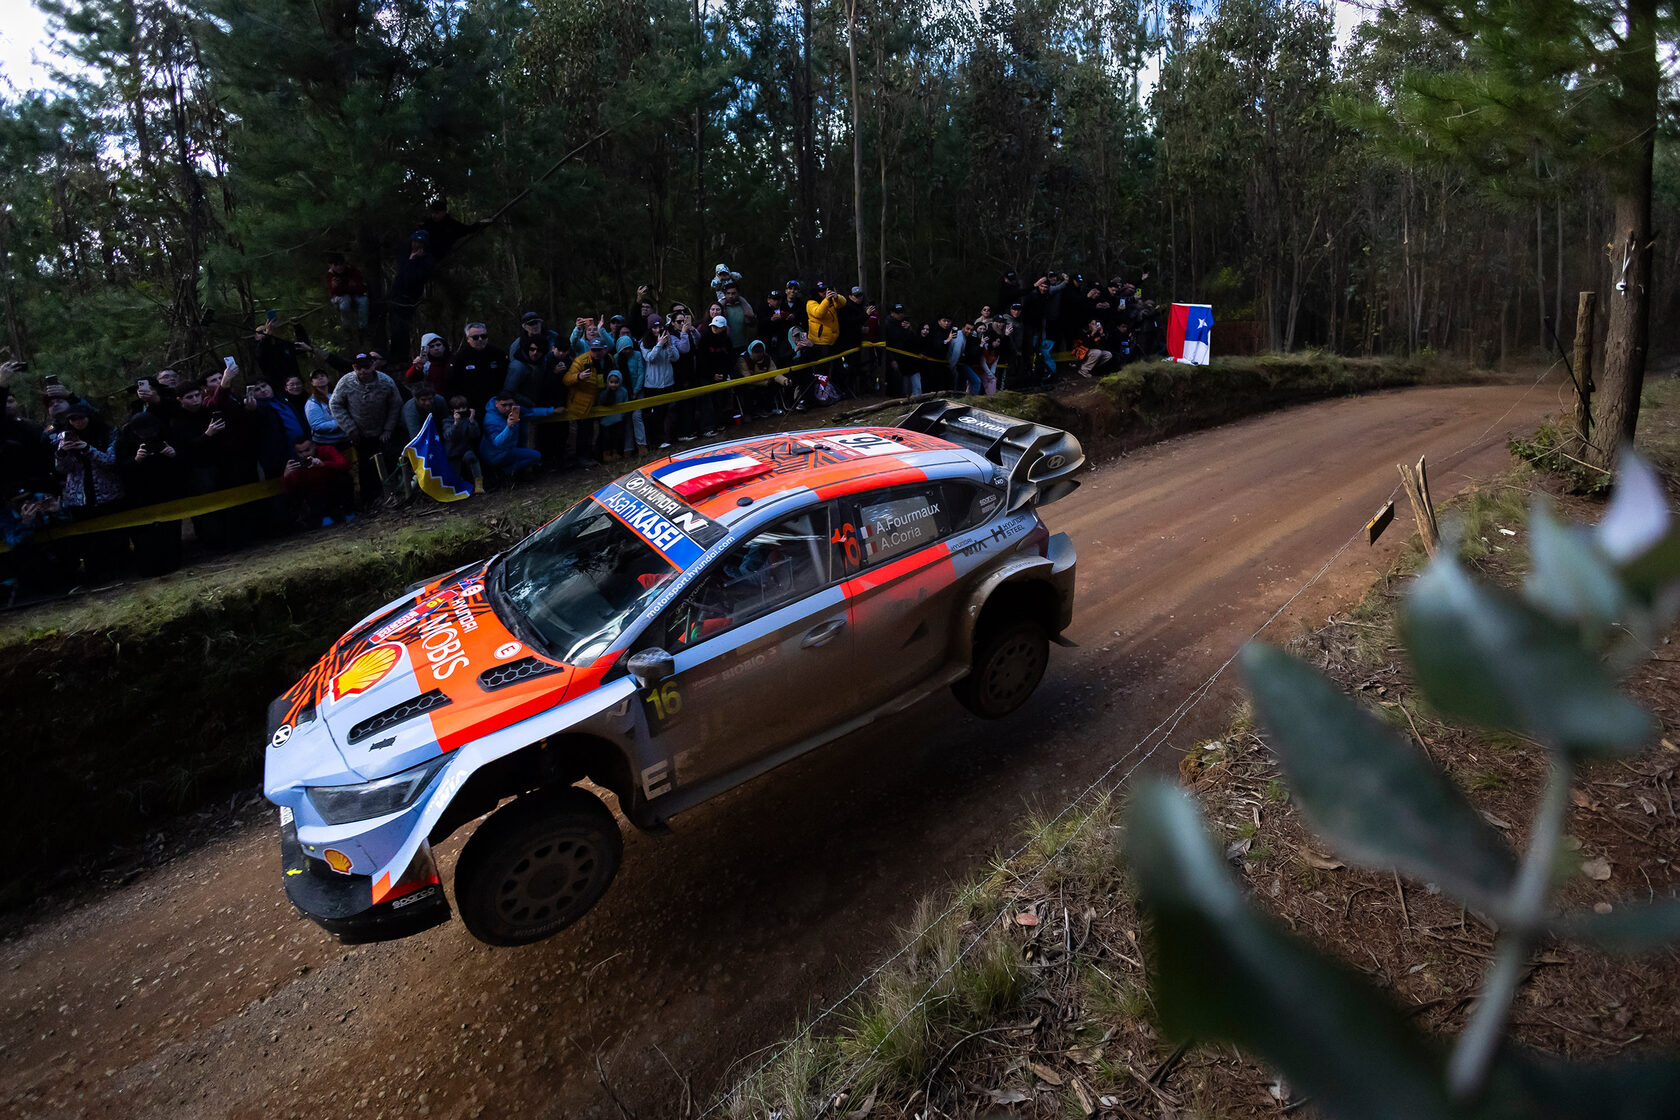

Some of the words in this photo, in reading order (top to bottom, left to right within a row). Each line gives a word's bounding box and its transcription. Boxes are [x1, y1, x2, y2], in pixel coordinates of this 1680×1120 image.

[838, 436, 892, 450] 16
[639, 484, 682, 516] HYUNDAI
[876, 503, 940, 534] A.Fourmaux
[831, 522, 862, 569] 16
[881, 526, 922, 551] A.Coria
[646, 536, 735, 619] motorsport.hyundai.com
[426, 596, 446, 608] 16
[450, 598, 479, 634] HYUNDAI
[417, 613, 470, 681] MOBIS
[646, 681, 682, 721] 16
[392, 887, 436, 910] sparco
